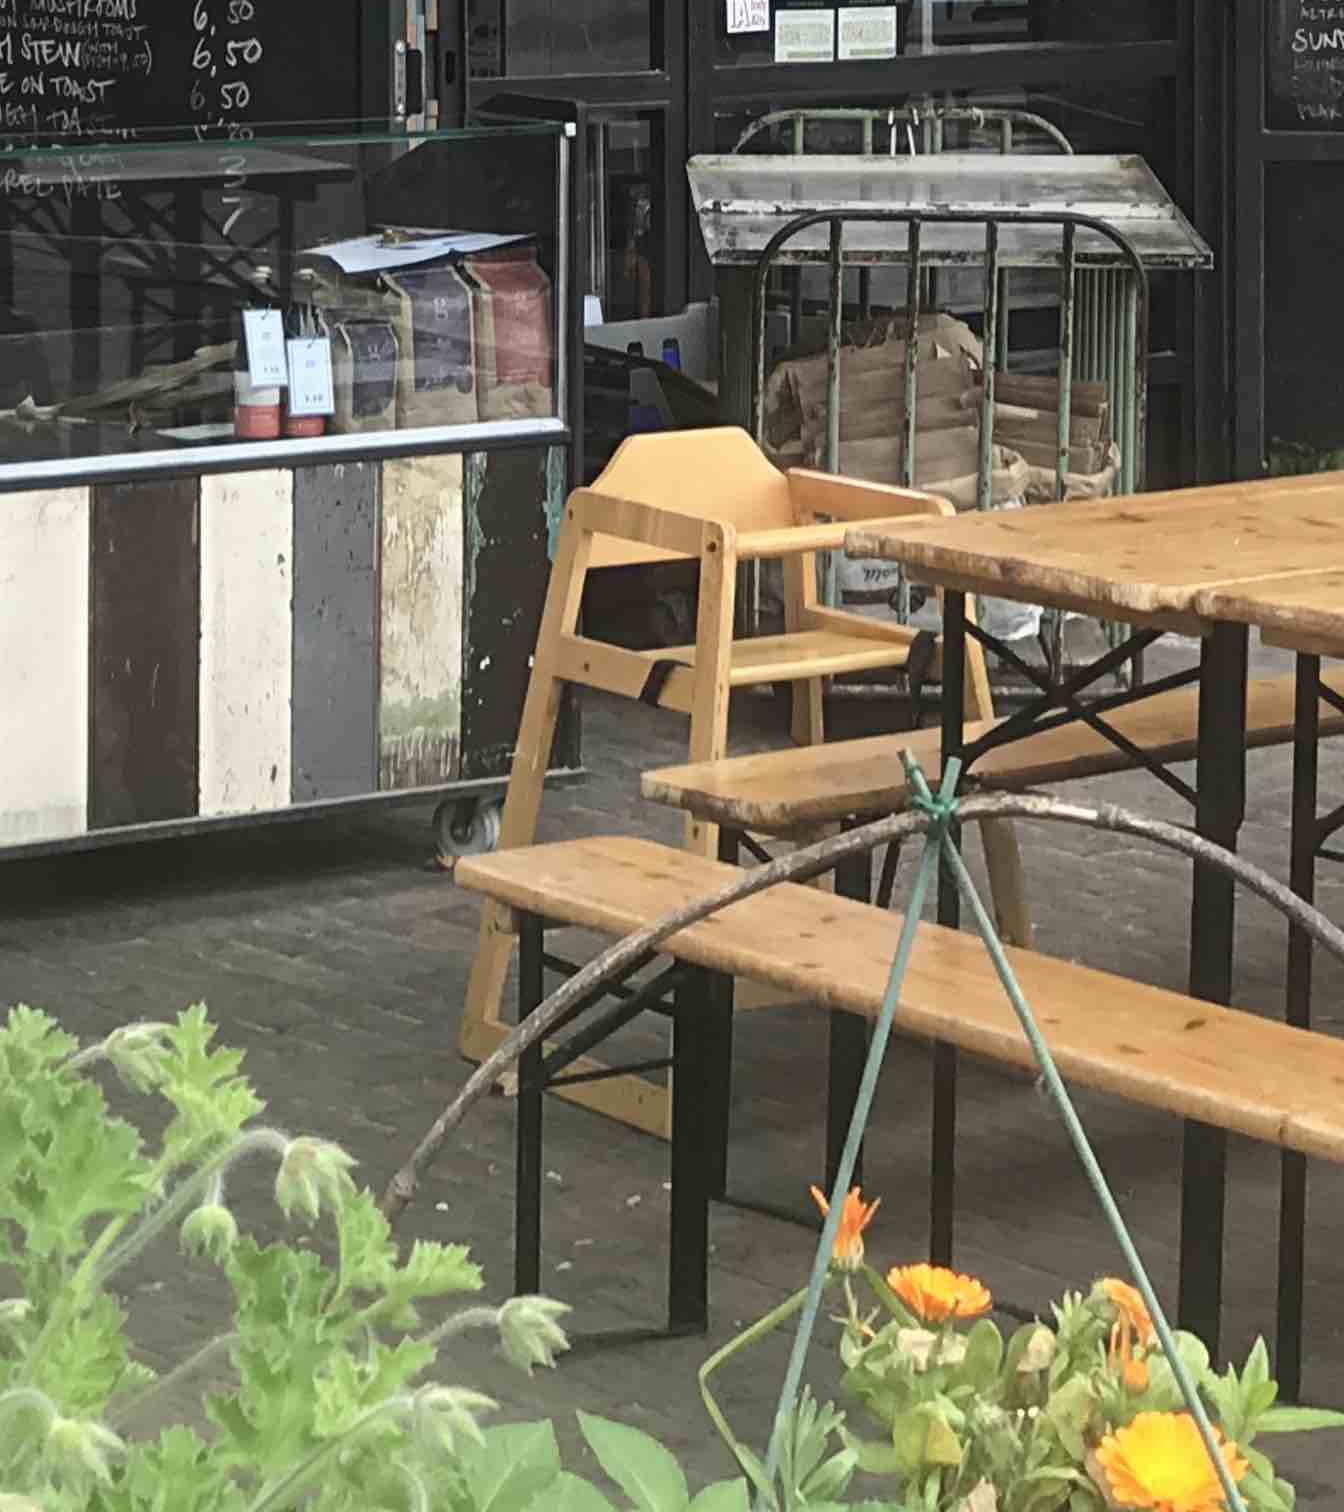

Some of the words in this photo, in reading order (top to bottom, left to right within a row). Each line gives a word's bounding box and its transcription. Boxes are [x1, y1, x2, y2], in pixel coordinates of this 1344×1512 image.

[21, 34, 81, 69] STEW
[22, 72, 45, 95] ON
[50, 77, 117, 103] TOAST
